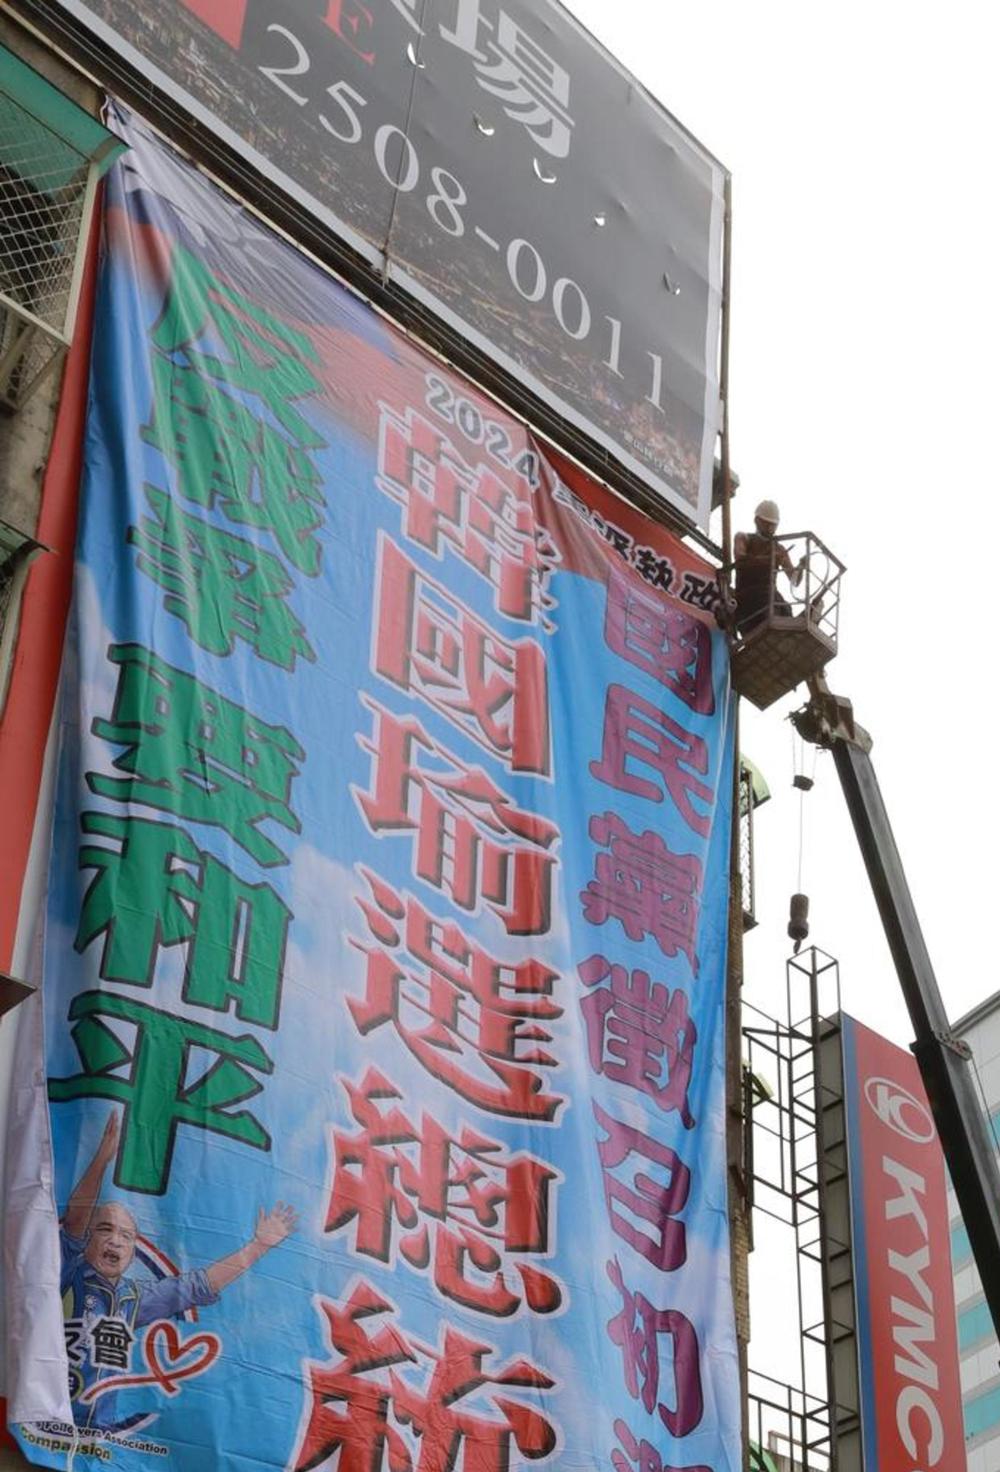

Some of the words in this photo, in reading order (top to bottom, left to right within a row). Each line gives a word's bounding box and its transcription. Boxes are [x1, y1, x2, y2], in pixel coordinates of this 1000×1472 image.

[258, 23, 666, 414] 2508-0011
[424, 372, 541, 493] 2024
[104, 1432, 168, 1456] Association
